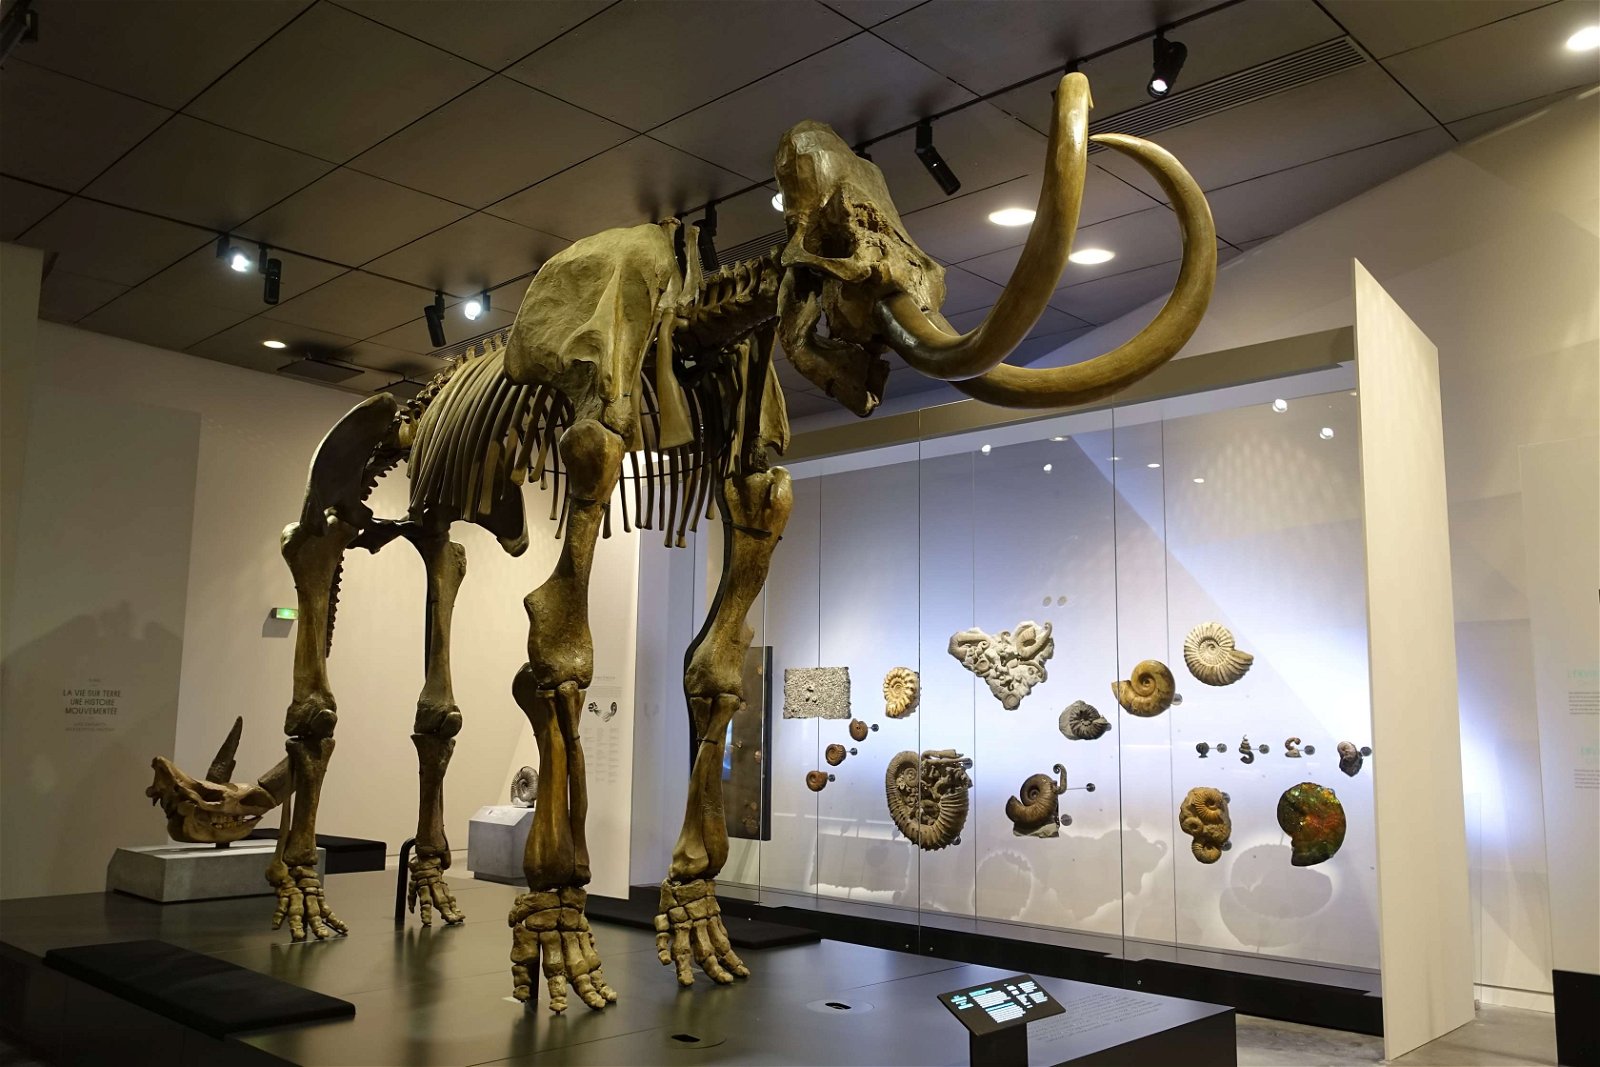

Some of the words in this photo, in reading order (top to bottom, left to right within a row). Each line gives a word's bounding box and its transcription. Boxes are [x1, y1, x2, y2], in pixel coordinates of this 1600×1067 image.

[63, 689, 72, 697] LA
[74, 689, 85, 697] VIE
[88, 689, 100, 697] SUR
[70, 698, 82, 706] UNE
[84, 698, 114, 706] HISTOIRE
